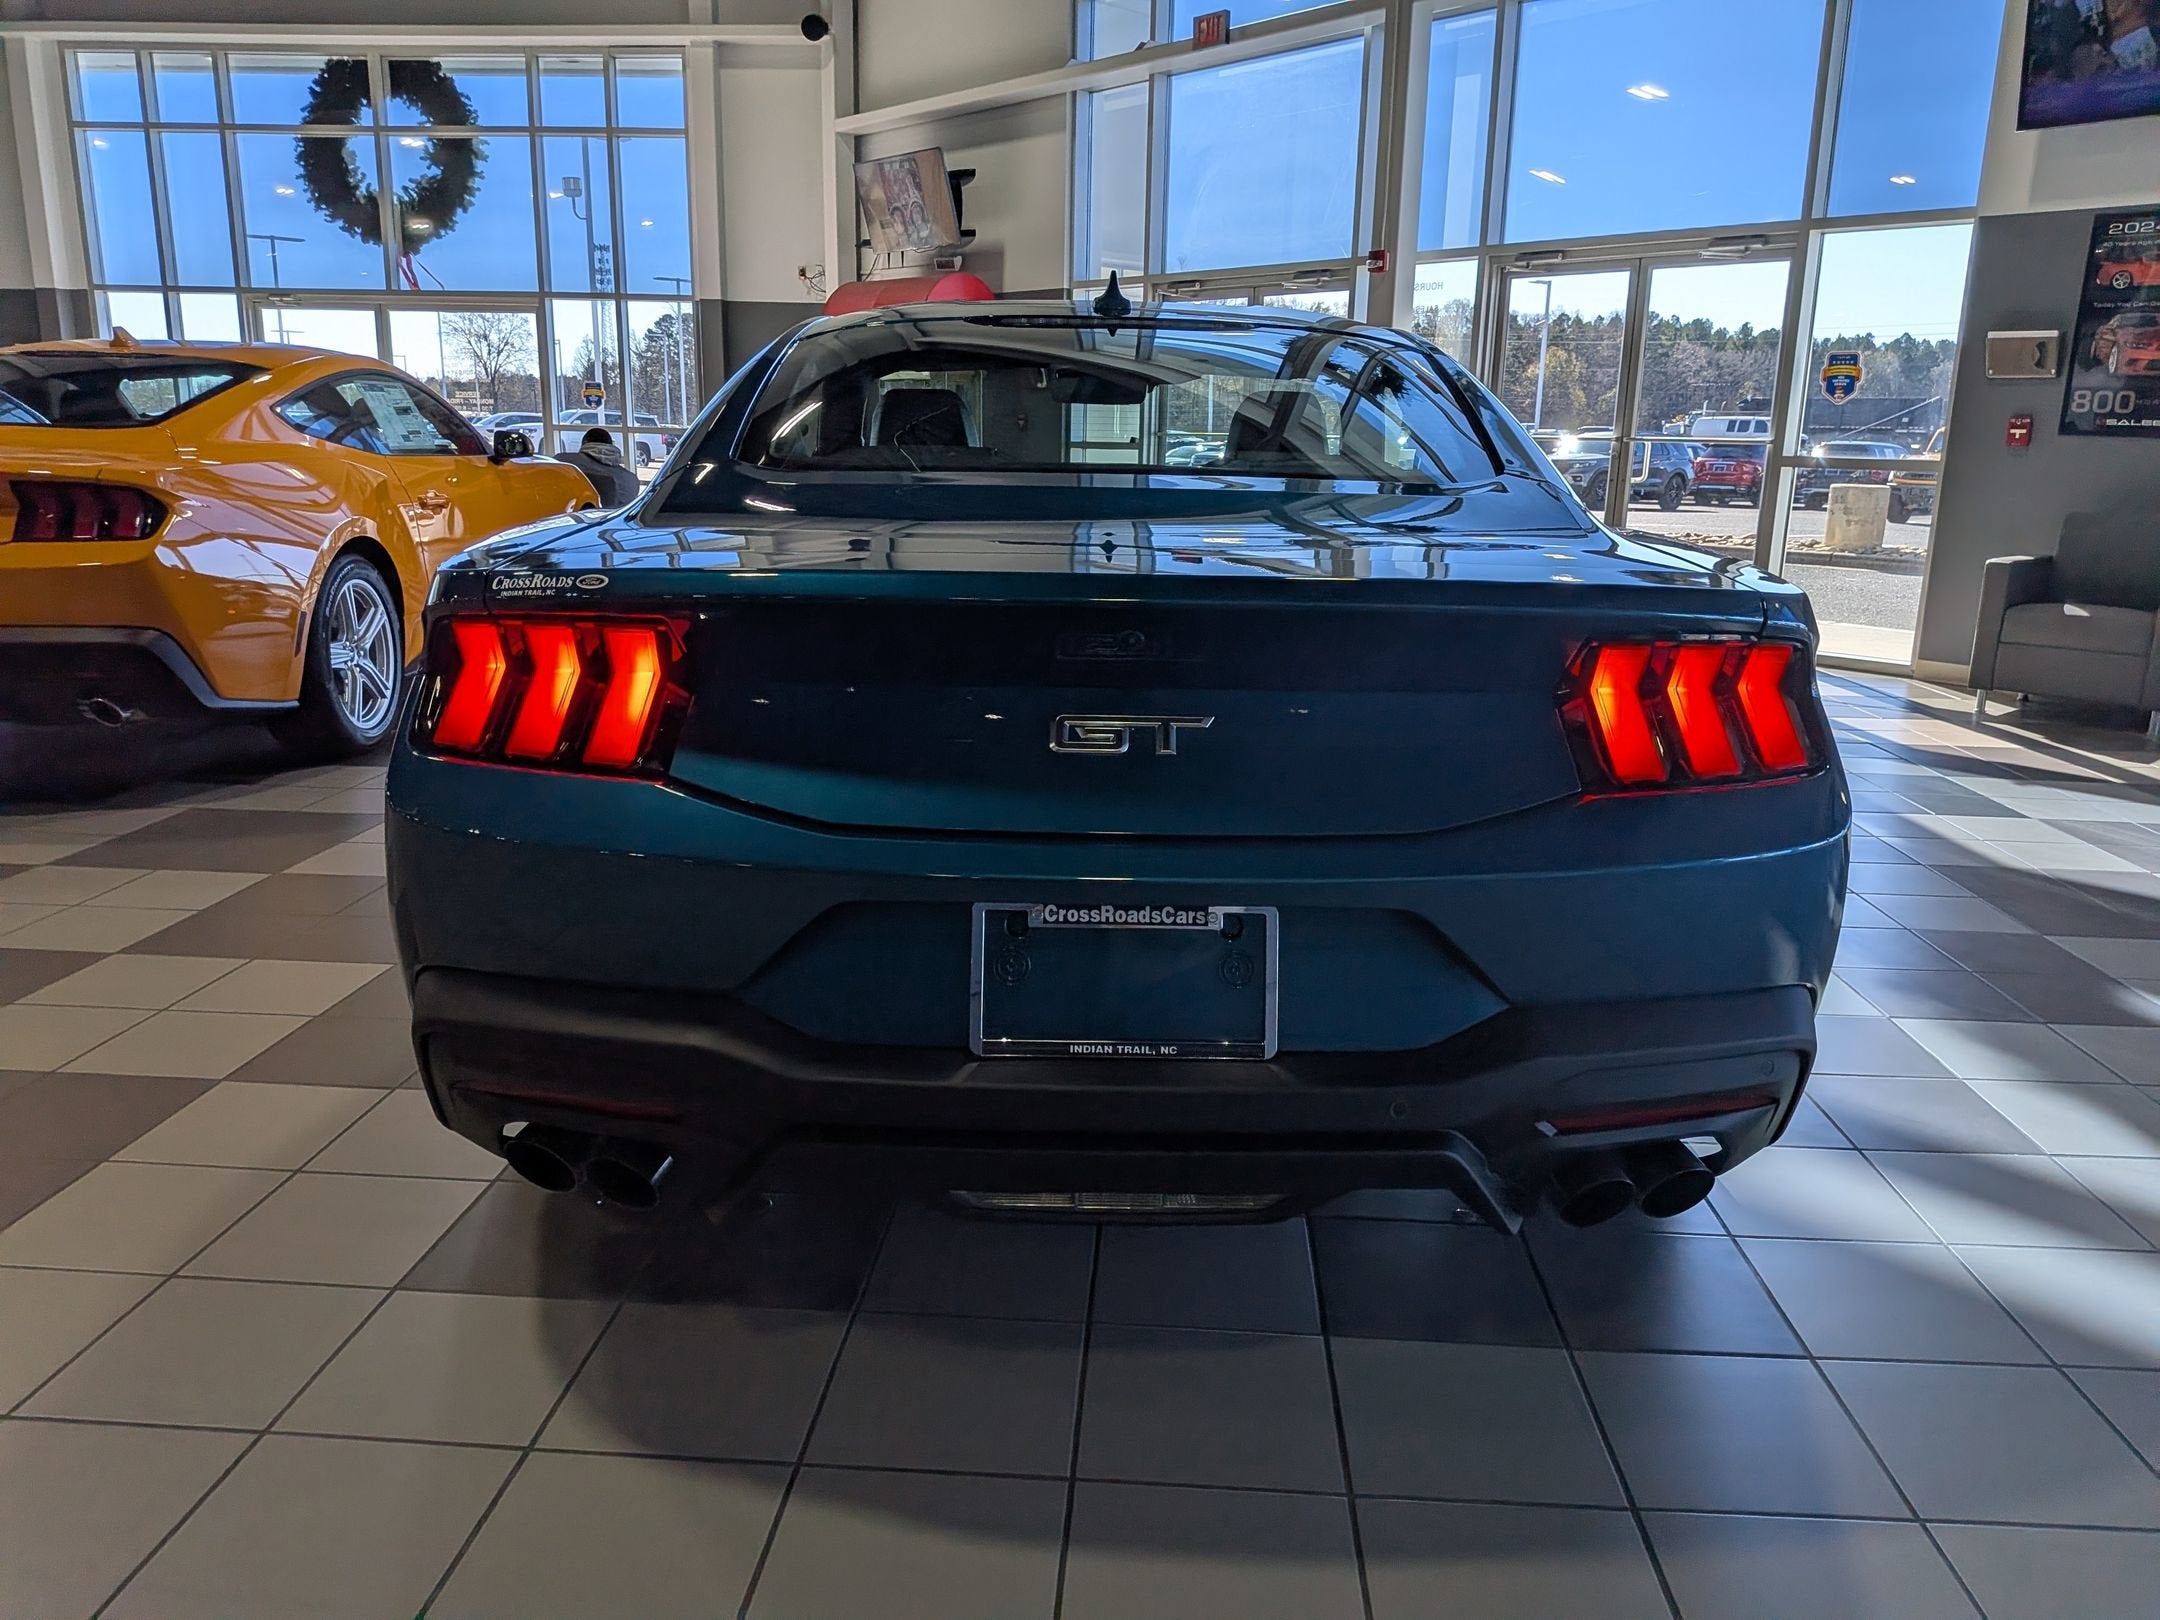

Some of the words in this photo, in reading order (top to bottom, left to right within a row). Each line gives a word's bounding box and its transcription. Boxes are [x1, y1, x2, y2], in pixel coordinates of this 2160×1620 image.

[1198, 15, 1223, 43] EXIT
[2071, 390, 2136, 414] 800
[524, 589, 545, 597] TRAIL,
[1050, 714, 1215, 755] GT
[1043, 904, 1206, 925] CrossRoadsCars
[1069, 1044, 1113, 1054] INDIAN
[1116, 1045, 1156, 1056] TRAIL,
[1160, 1046, 1178, 1055] NC
